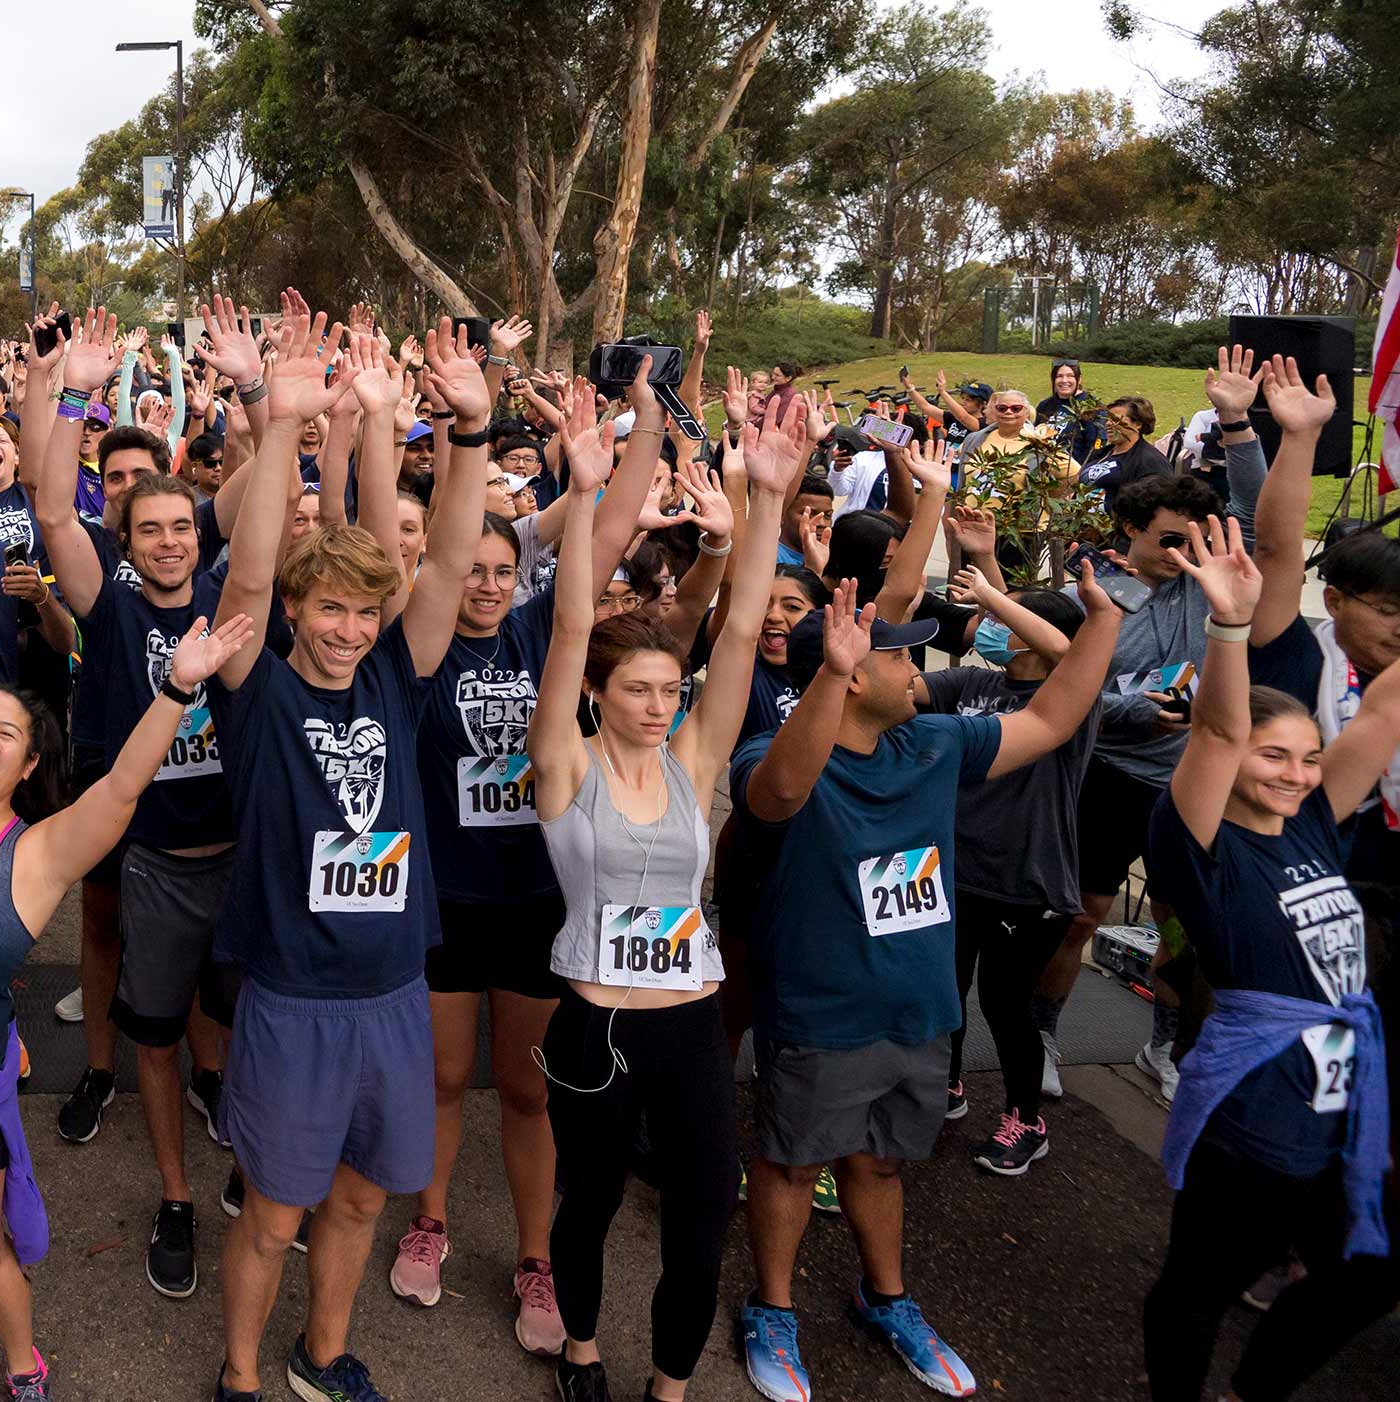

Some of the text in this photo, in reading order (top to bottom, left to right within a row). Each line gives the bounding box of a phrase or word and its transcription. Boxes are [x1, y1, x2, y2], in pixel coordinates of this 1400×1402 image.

[485, 700, 526, 723] 5K
[326, 757, 367, 780] 5K
[466, 780, 537, 813] 1034
[319, 861, 400, 898] 1030
[871, 877, 938, 921] 2149
[1323, 918, 1355, 953] 5K
[609, 935, 692, 974] 1884
